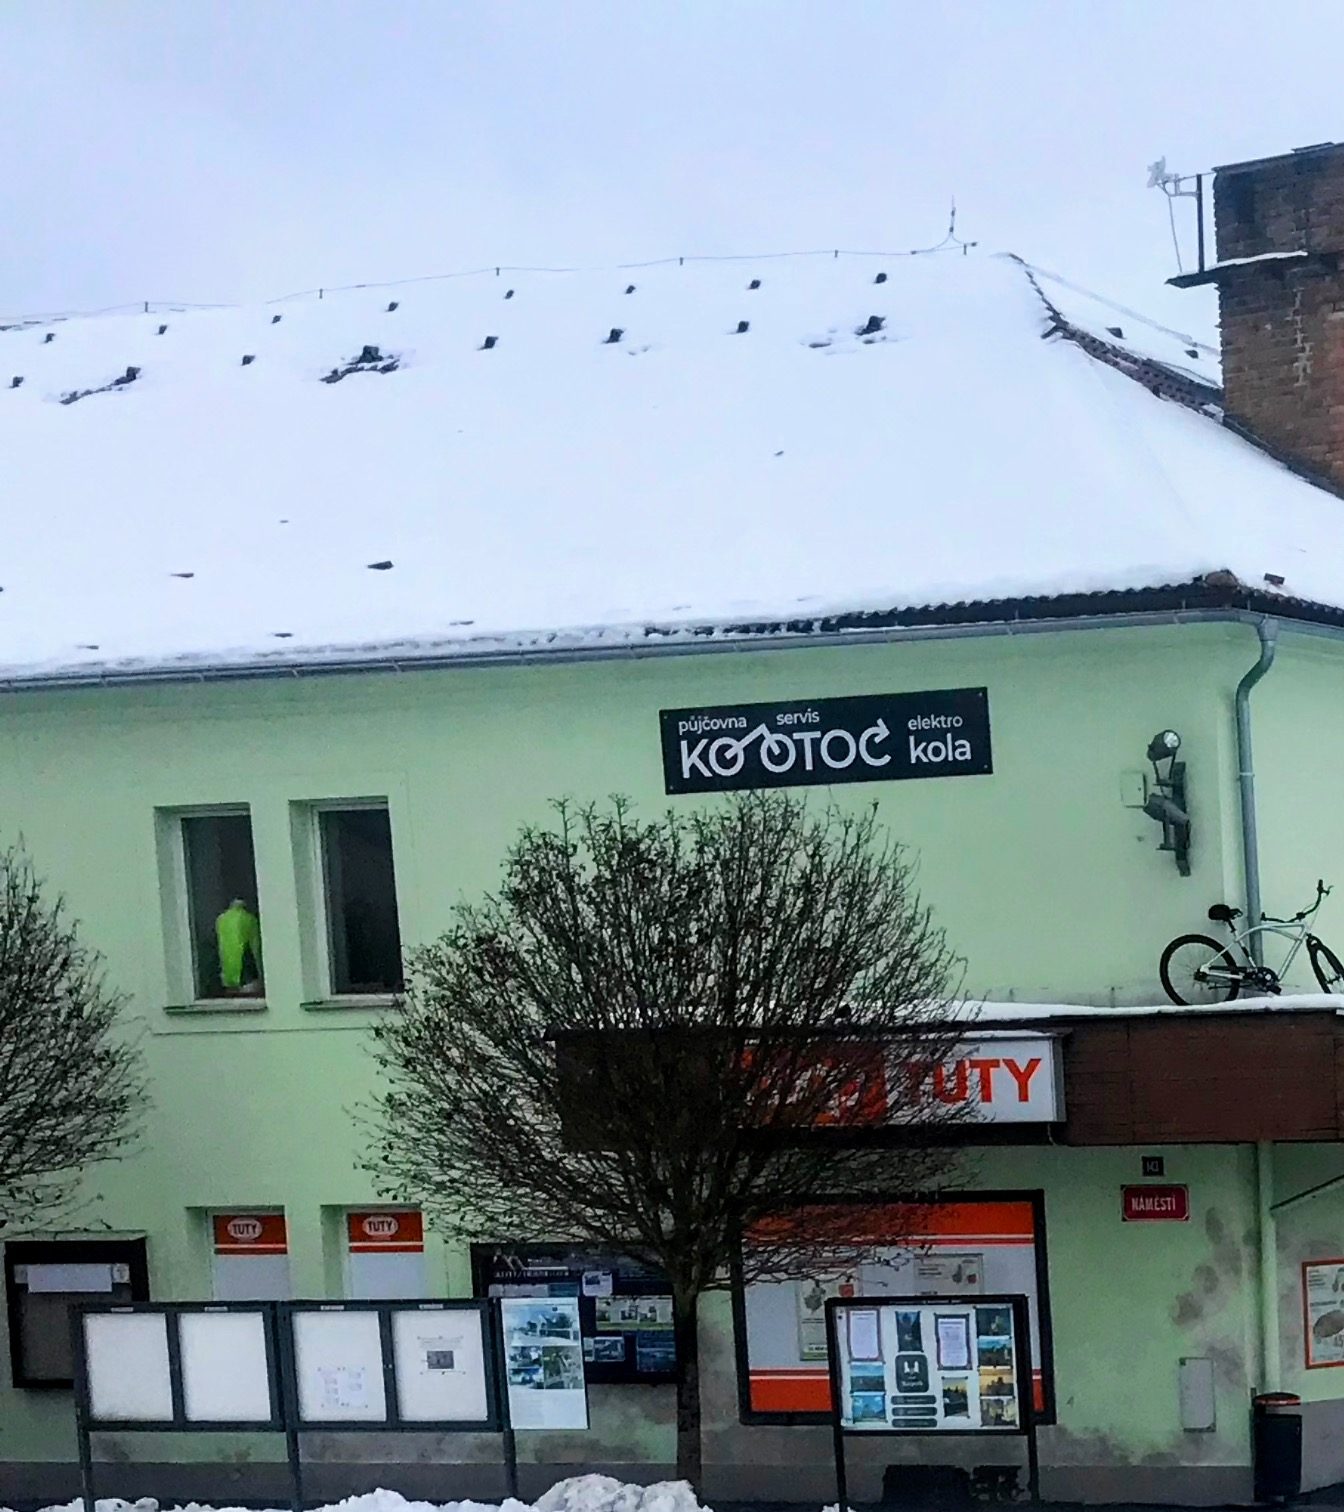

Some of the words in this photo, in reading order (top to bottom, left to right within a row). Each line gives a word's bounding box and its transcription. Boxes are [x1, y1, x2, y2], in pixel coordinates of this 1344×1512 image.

[678, 715, 747, 735] půjčovna
[776, 708, 820, 726] servis
[908, 713, 963, 730] elektro
[909, 732, 972, 764] kola
[1131, 1195, 1176, 1211] NÁMĚSTÍ
[232, 1221, 258, 1236] TUTY
[366, 1220, 394, 1233] TUTY
